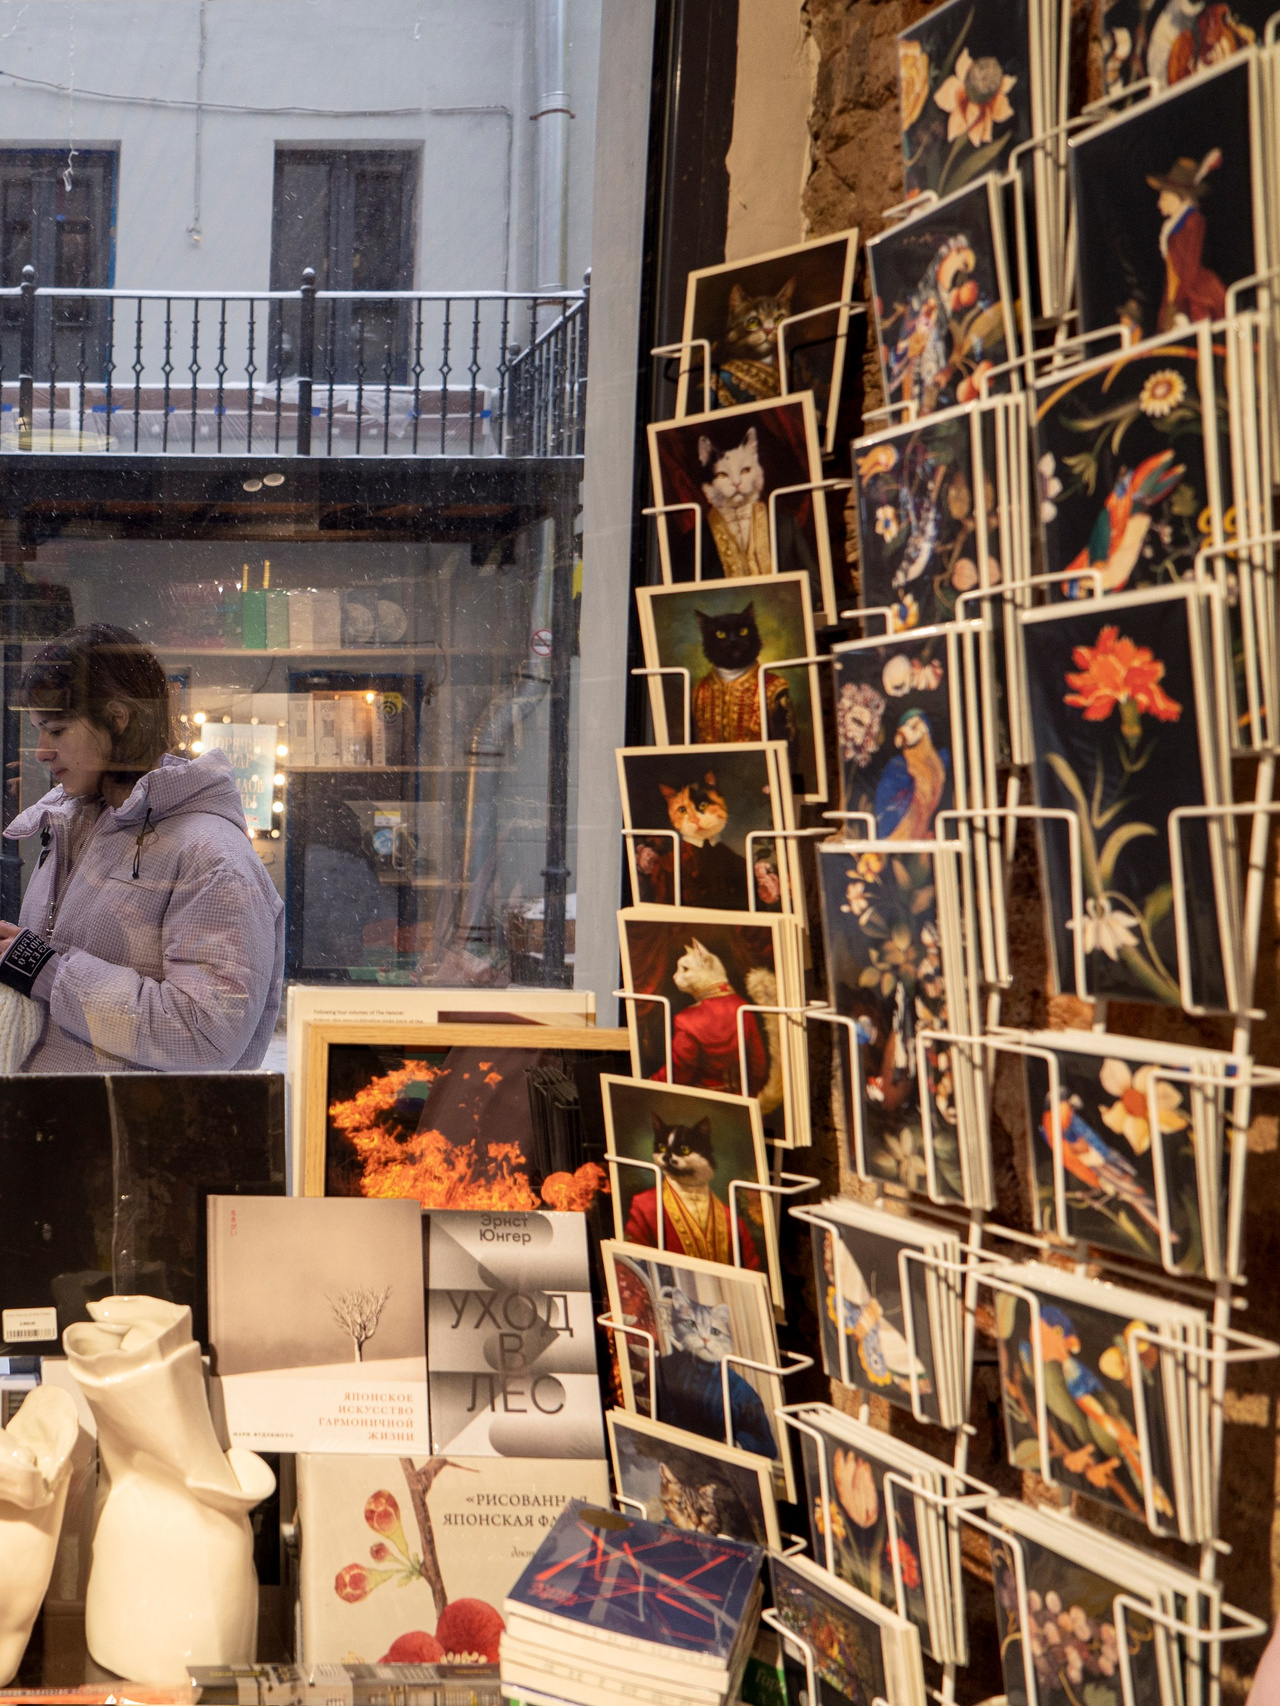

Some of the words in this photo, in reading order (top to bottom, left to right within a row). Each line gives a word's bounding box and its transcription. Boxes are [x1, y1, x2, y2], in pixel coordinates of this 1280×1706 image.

[480, 1213, 528, 1228] Эрнст
[479, 1228, 532, 1245] Юнгер
[445, 1291, 574, 1338] УХОД
[499, 1332, 526, 1371] В
[343, 1391, 414, 1403] ЯПОНСКОЕ
[466, 1375, 567, 1414] ЛЕС
[338, 1404, 414, 1415] ИСКУССТВО
[318, 1416, 414, 1428] ГАРМОНИЧНОЙ
[368, 1431, 414, 1441] ЖИЗНИ
[443, 1513, 534, 1528] ЯПОНСКАЯ
